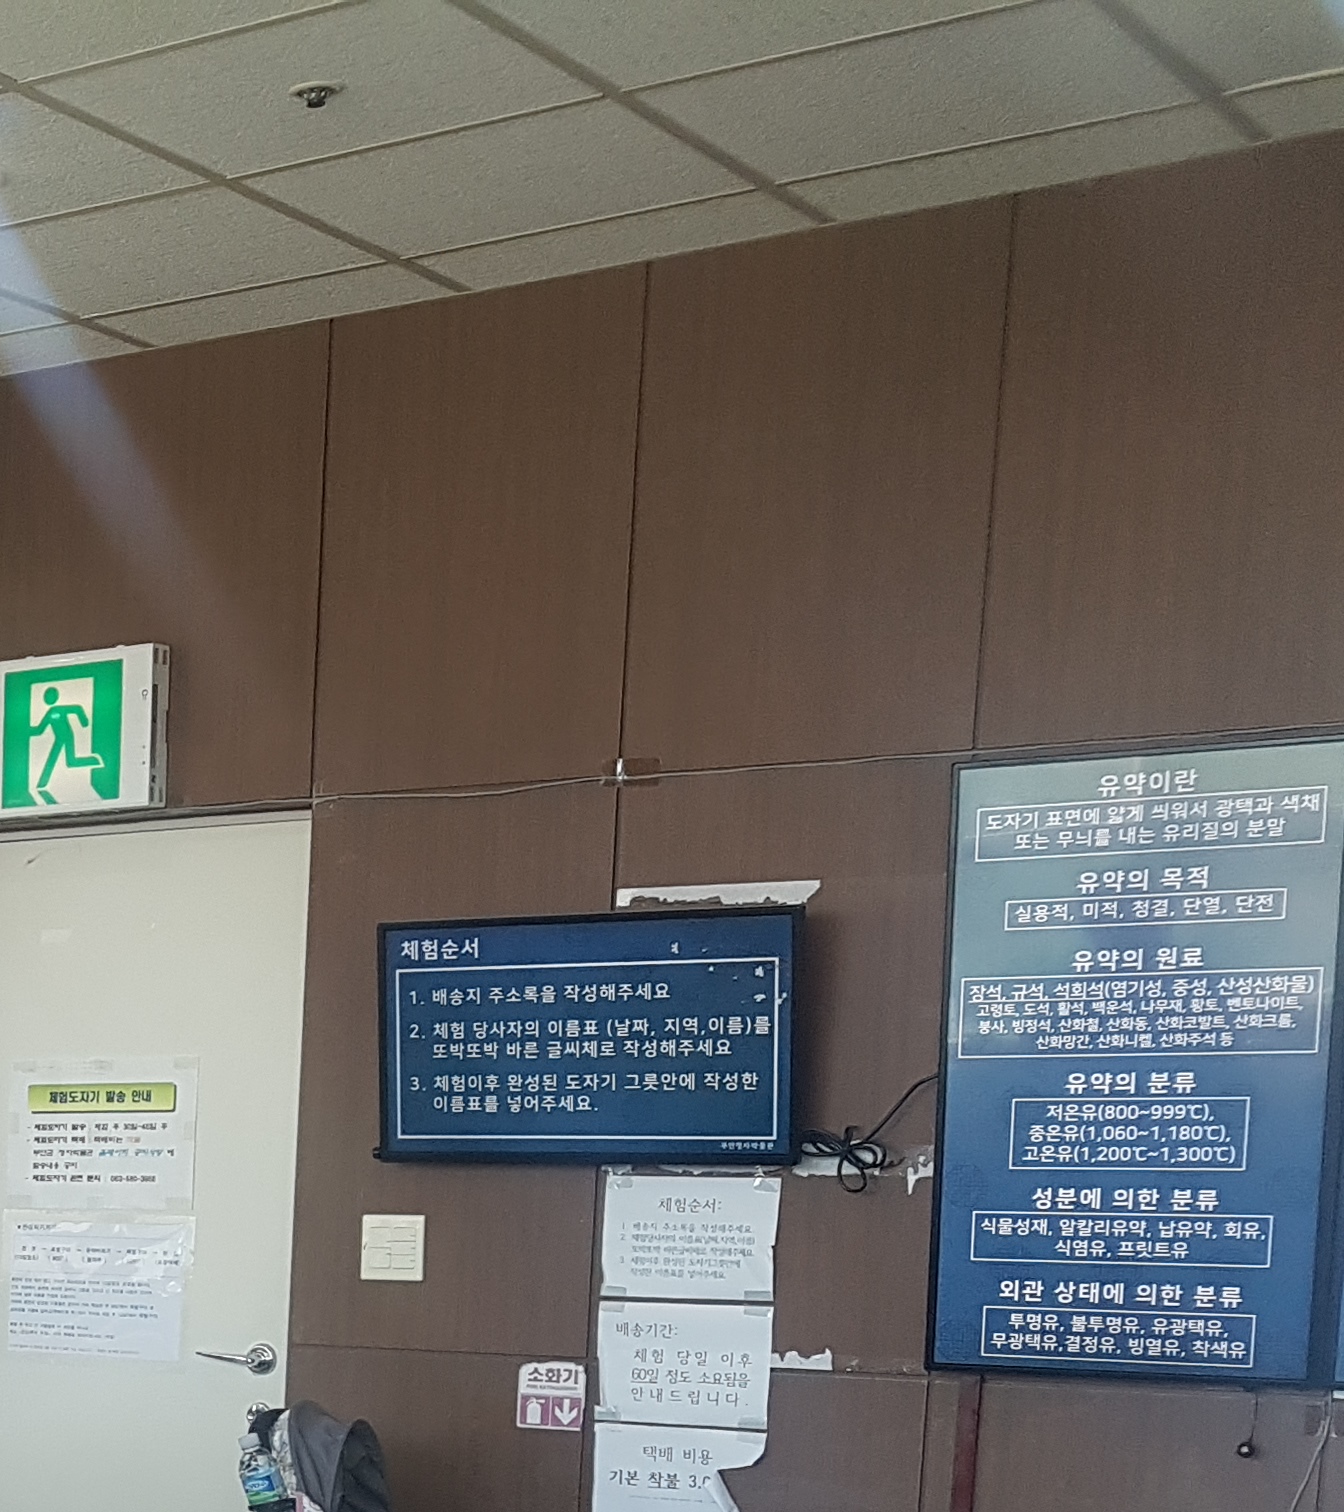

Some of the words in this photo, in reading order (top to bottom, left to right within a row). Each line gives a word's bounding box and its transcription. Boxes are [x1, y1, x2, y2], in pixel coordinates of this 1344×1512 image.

[1097, 768, 1200, 796] 유약이란
[986, 812, 1040, 831] 도자기
[1046, 807, 1100, 827] 표면에
[1108, 804, 1144, 824] 얇게
[1151, 801, 1208, 821] 씌워서
[1215, 796, 1274, 816] 광택과
[1281, 793, 1320, 813] 색채
[1014, 833, 1050, 850] 또는
[1056, 829, 1111, 848] 무늬를
[1119, 826, 1156, 845] 내는
[1162, 820, 1239, 843] 유리질의
[1245, 818, 1287, 837] 분말
[1076, 868, 1150, 894] 유약의
[1160, 866, 1210, 890] 목적
[1015, 903, 1075, 923] 실용적,
[1082, 901, 1125, 920] 미적,
[1131, 899, 1175, 918] 청결,
[1183, 897, 1227, 916] 단열,
[1235, 893, 1274, 914] 단전
[400, 937, 480, 961] 체험순서
[1071, 948, 1145, 972] 유약의
[1155, 946, 1204, 970] 원료
[409, 990, 425, 1006] 1.
[432, 988, 481, 1007] 배송지
[489, 986, 557, 1005] 주소록을
[563, 983, 671, 1003] 작성해주세요
[969, 983, 1006, 1002] 장석,
[1011, 983, 1048, 1001] 규석,
[1172, 978, 1212, 997] 중성,
[1217, 976, 1315, 995] 산성산화물)
[975, 1003, 1019, 1018] 고령토,
[1023, 1002, 1052, 1017] 도석,
[1141, 999, 1185, 1014] 나무재,
[1227, 996, 1303, 1013] 벤토나이트,
[410, 1024, 426, 1040] 2.
[433, 1022, 465, 1040] 체험
[472, 1020, 540, 1039] 당사자의
[547, 1019, 599, 1037] 이름표
[606, 1018, 655, 1038] (날짜,
[978, 1020, 1008, 1035] 붕사,
[1013, 1019, 1055, 1034] 빙정석,
[1058, 1018, 1102, 1033] 산화철,
[1106, 1018, 1152, 1032] 산화동,
[1156, 1016, 1230, 1031] 산화코발트,
[1234, 1013, 1297, 1029] 산화크롬,
[432, 1041, 498, 1060] 또박또박
[506, 1040, 540, 1058] 바른
[547, 1040, 616, 1058] 글씨체로
[622, 1038, 732, 1057] 작성해주세요
[1036, 1034, 1094, 1049] 산화망간,
[1097, 1033, 1156, 1049] 산화니켈,
[1160, 1032, 1218, 1047] 산화주석
[1220, 1033, 1234, 1047] 등
[410, 1076, 426, 1092] 3.
[433, 1073, 500, 1092] 체험이후
[507, 1073, 557, 1092] 완성된
[565, 1072, 617, 1090] 도자기
[624, 1072, 696, 1090] 그릇안에
[704, 1071, 759, 1090] 작성한
[1065, 1073, 1136, 1095] 유약의
[1147, 1072, 1197, 1093] 분류
[49, 1091, 99, 1104] 체험도자기
[106, 1091, 126, 1103] 발송
[132, 1090, 152, 1102] 안내
[433, 1094, 499, 1113] 이름표를
[507, 1094, 598, 1113] 넣어주세요.
[658, 1197, 722, 1213] 체험순서:
[1031, 1188, 1101, 1210] 성분에
[1112, 1188, 1160, 1210] 의한
[1171, 1189, 1219, 1211] 분류
[981, 1219, 1052, 1236] 식물성재,
[1060, 1220, 1152, 1238] 알칼리유약,
[1159, 1221, 1217, 1239] 납유약,
[1224, 1221, 1265, 1240] 회유,
[1054, 1240, 1111, 1258] 식염유,
[1118, 1240, 1189, 1258] 프릿트유
[999, 1280, 1044, 1302] 외관
[1054, 1282, 1124, 1304] 상태에
[1135, 1284, 1183, 1306] 의한
[1193, 1286, 1243, 1307] 분류
[616, 1322, 678, 1339] 배송기간:
[1009, 1314, 1065, 1331] 투명유,
[1071, 1315, 1144, 1333] 불투명유,
[1152, 1318, 1228, 1337] 유광택유,
[634, 1348, 663, 1364] 체험
[677, 1350, 707, 1366] 당일
[721, 1352, 753, 1368] 이후
[1129, 1338, 1185, 1356] 빙열유,
[1192, 1340, 1247, 1358] 착색유
[528, 1367, 578, 1384] 소화기
[631, 1368, 659, 1384] 60일
[666, 1369, 692, 1384] 정도
[697, 1372, 750, 1388] 소요됨을
[643, 1446, 672, 1462] 택배
[683, 1449, 713, 1465] 비용
[609, 1469, 639, 1486] 기본
[648, 1472, 680, 1489] 착불
